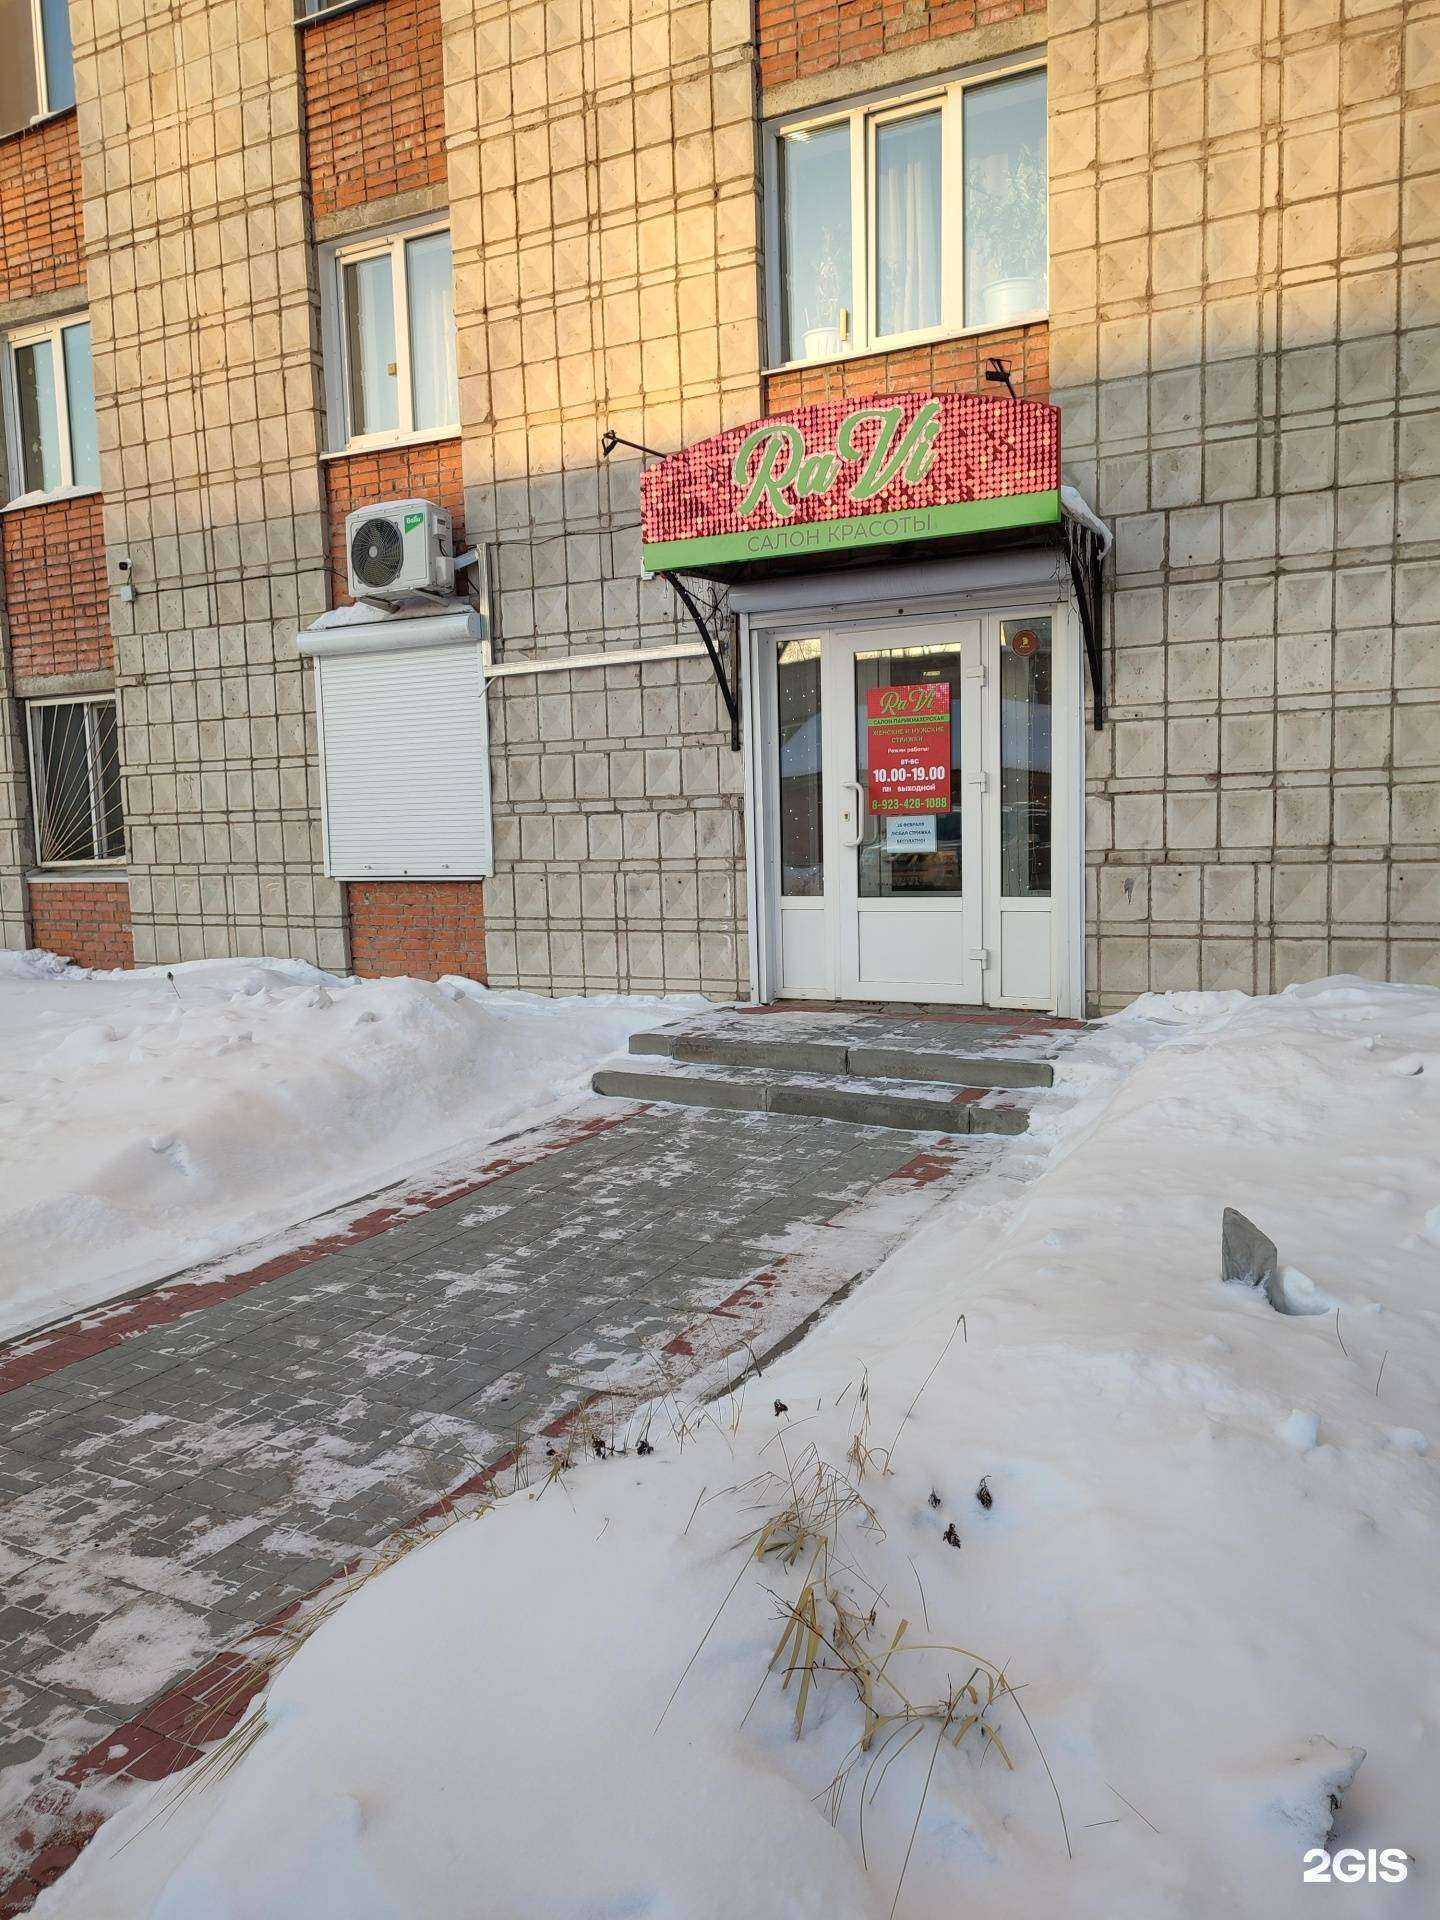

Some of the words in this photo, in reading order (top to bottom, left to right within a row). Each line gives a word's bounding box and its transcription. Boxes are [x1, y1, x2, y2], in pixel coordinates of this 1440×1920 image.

[732, 399, 943, 518] RaVi
[747, 527, 820, 553] САЛОН
[828, 515, 933, 543] КРАСОТЫ
[873, 765, 946, 782] 10.00-19.00
[897, 783, 936, 793] ВЫХОДНОЙ
